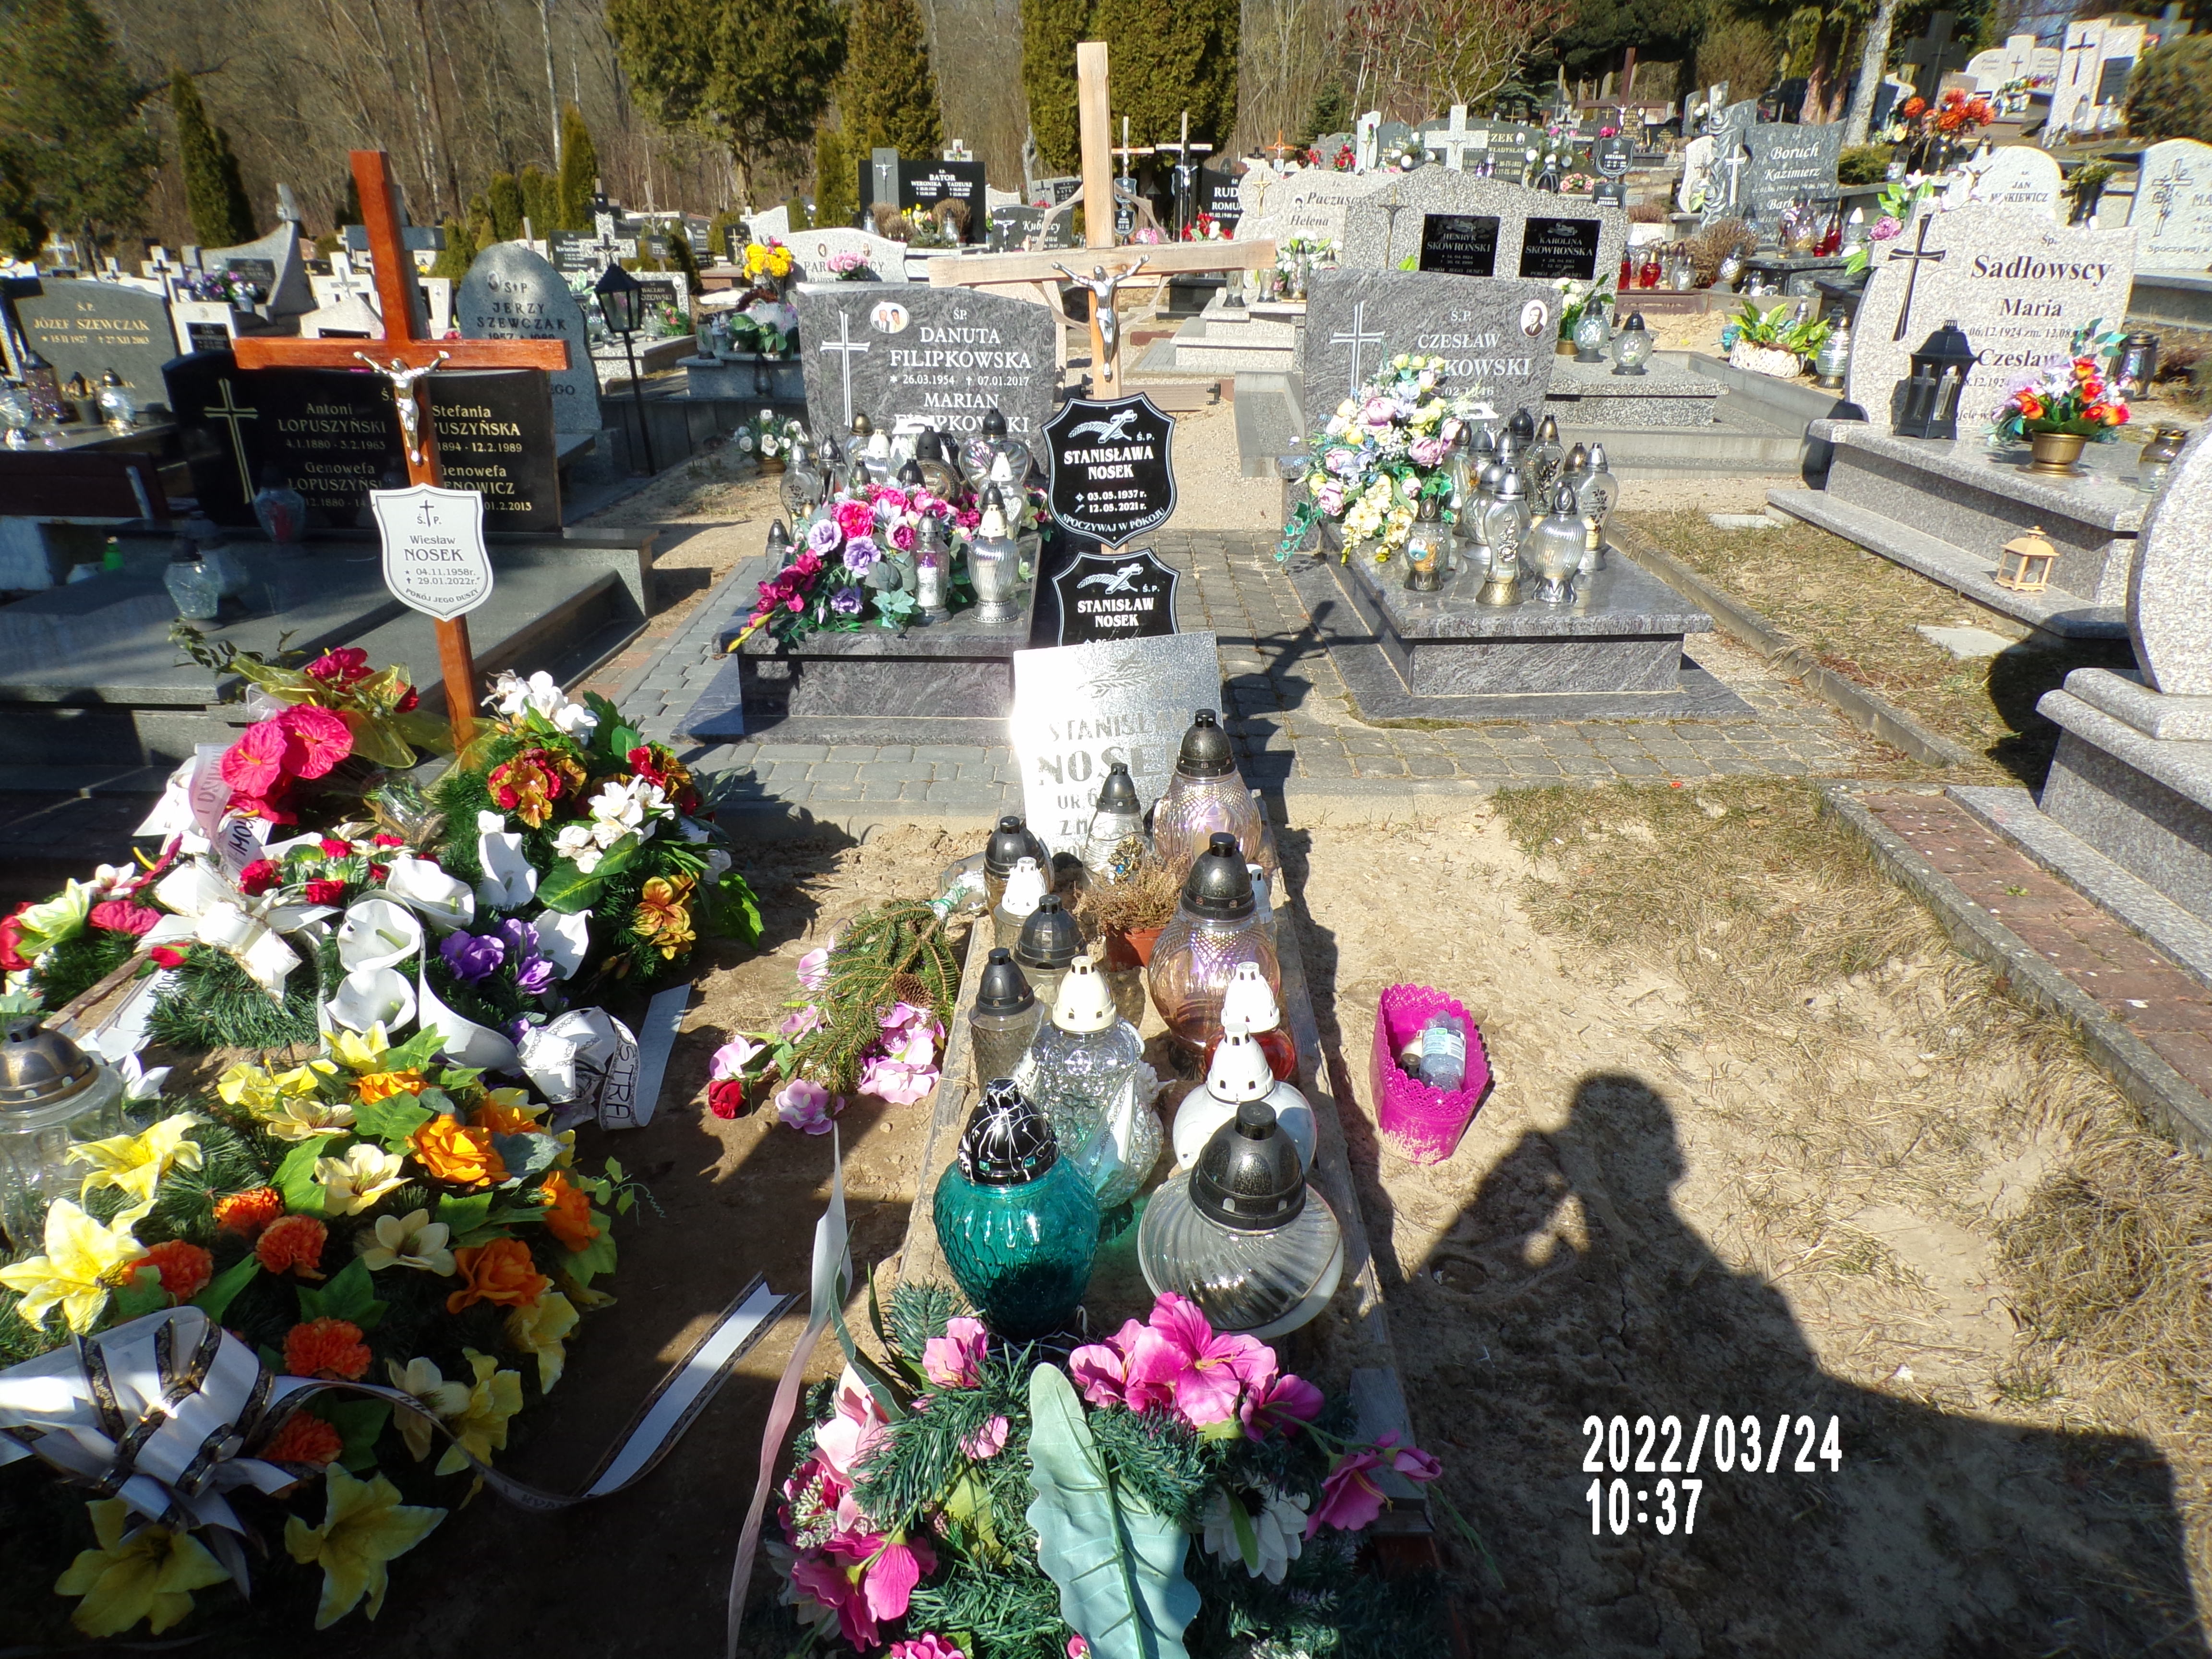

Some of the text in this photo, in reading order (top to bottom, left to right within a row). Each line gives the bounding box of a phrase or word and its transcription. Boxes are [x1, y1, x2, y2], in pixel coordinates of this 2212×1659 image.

[1770, 141, 1820, 160] Boruch
[1764, 167, 1822, 182] Kazimierz
[1290, 215, 1329, 226] Helena
[1426, 240, 1491, 252] SKOWROŃSKI
[1525, 244, 1593, 256] SKOWROŃSKA
[1971, 254, 2112, 287] Sadłowscy
[492, 302, 545, 314] JERZY
[1998, 298, 2063, 317] Maria
[33, 316, 150, 331] JÓZEF SZEWCZAK
[477, 316, 567, 331] SZEWCZAK
[920, 326, 1001, 344] DANUTA
[1418, 333, 1501, 349] CZESŁAW
[890, 349, 1032, 369] FILIPKOWSKA
[902, 374, 1030, 386] 26.03.1954 07.01.2017
[924, 392, 999, 409] MARIAN
[306, 403, 492, 418] Antoni Stefania
[472, 442, 523, 453] 12.2.1989
[1063, 445, 1154, 465] STANISŁAWA
[304, 461, 375, 474] Genowefa
[1088, 464, 1134, 481] NOSEK
[1087, 489, 1139, 501] 03.05.1937
[1089, 502, 1139, 513] 12.05.2021
[1061, 506, 1166, 532] SPOCZYWAJ W POKOJU
[409, 535, 456, 545] Wiesław
[404, 548, 465, 562] NOSEK
[415, 567, 476, 576] 04.11.1958r.
[417, 577, 477, 585] 29.01.2022r.
[405, 588, 432, 602] POKÓJ
[456, 588, 479, 602] DUSZY
[1077, 597, 1154, 613] STANISŁAW
[1094, 614, 1140, 628] NOSEK
